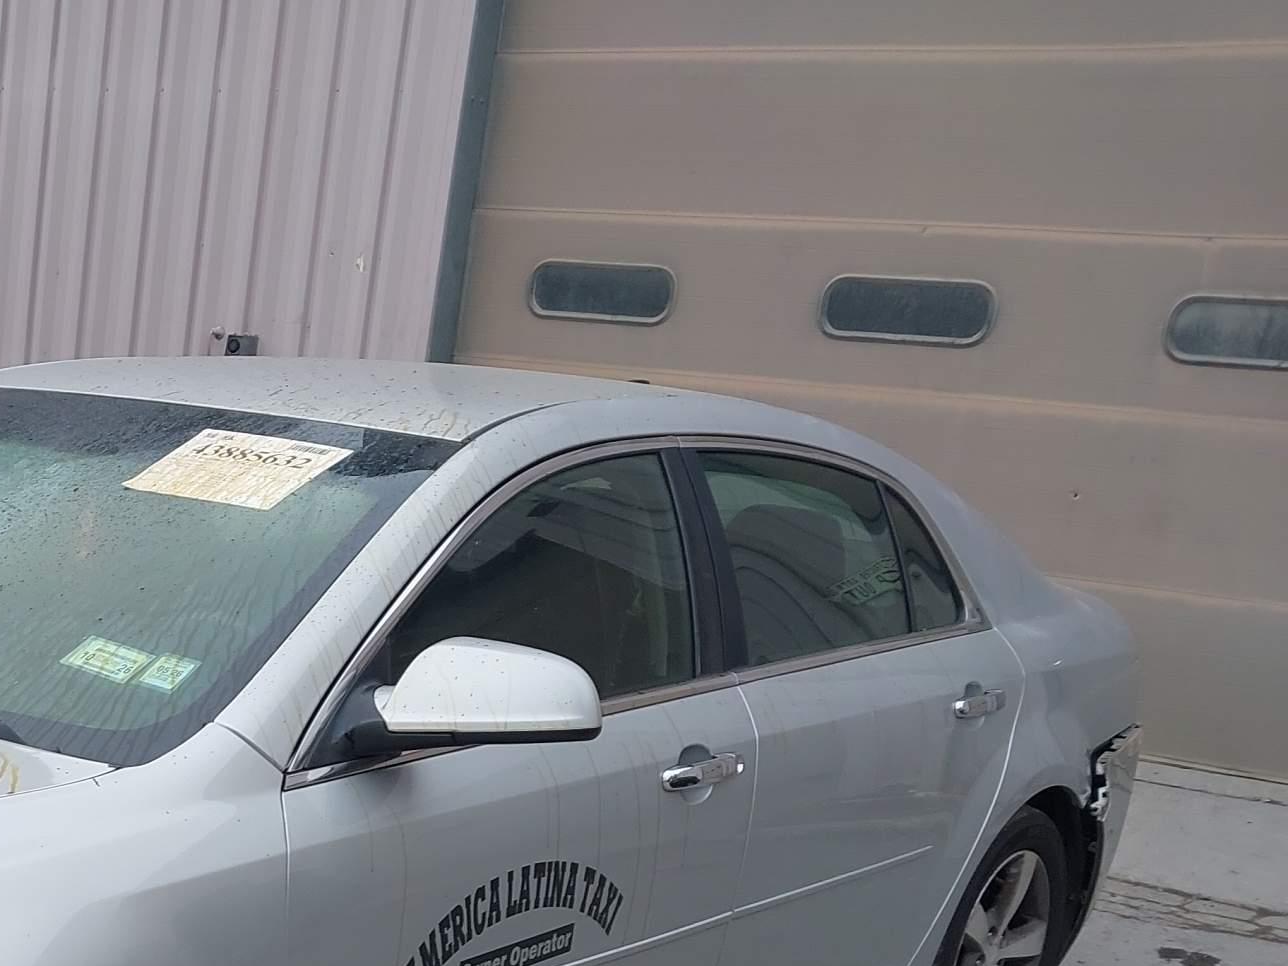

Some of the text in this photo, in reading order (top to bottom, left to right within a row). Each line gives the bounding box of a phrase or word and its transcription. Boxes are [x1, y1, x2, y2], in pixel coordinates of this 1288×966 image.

[192, 443, 312, 469] 43885632
[505, 860, 579, 919] LATINA
[579, 866, 624, 936] TAXI
